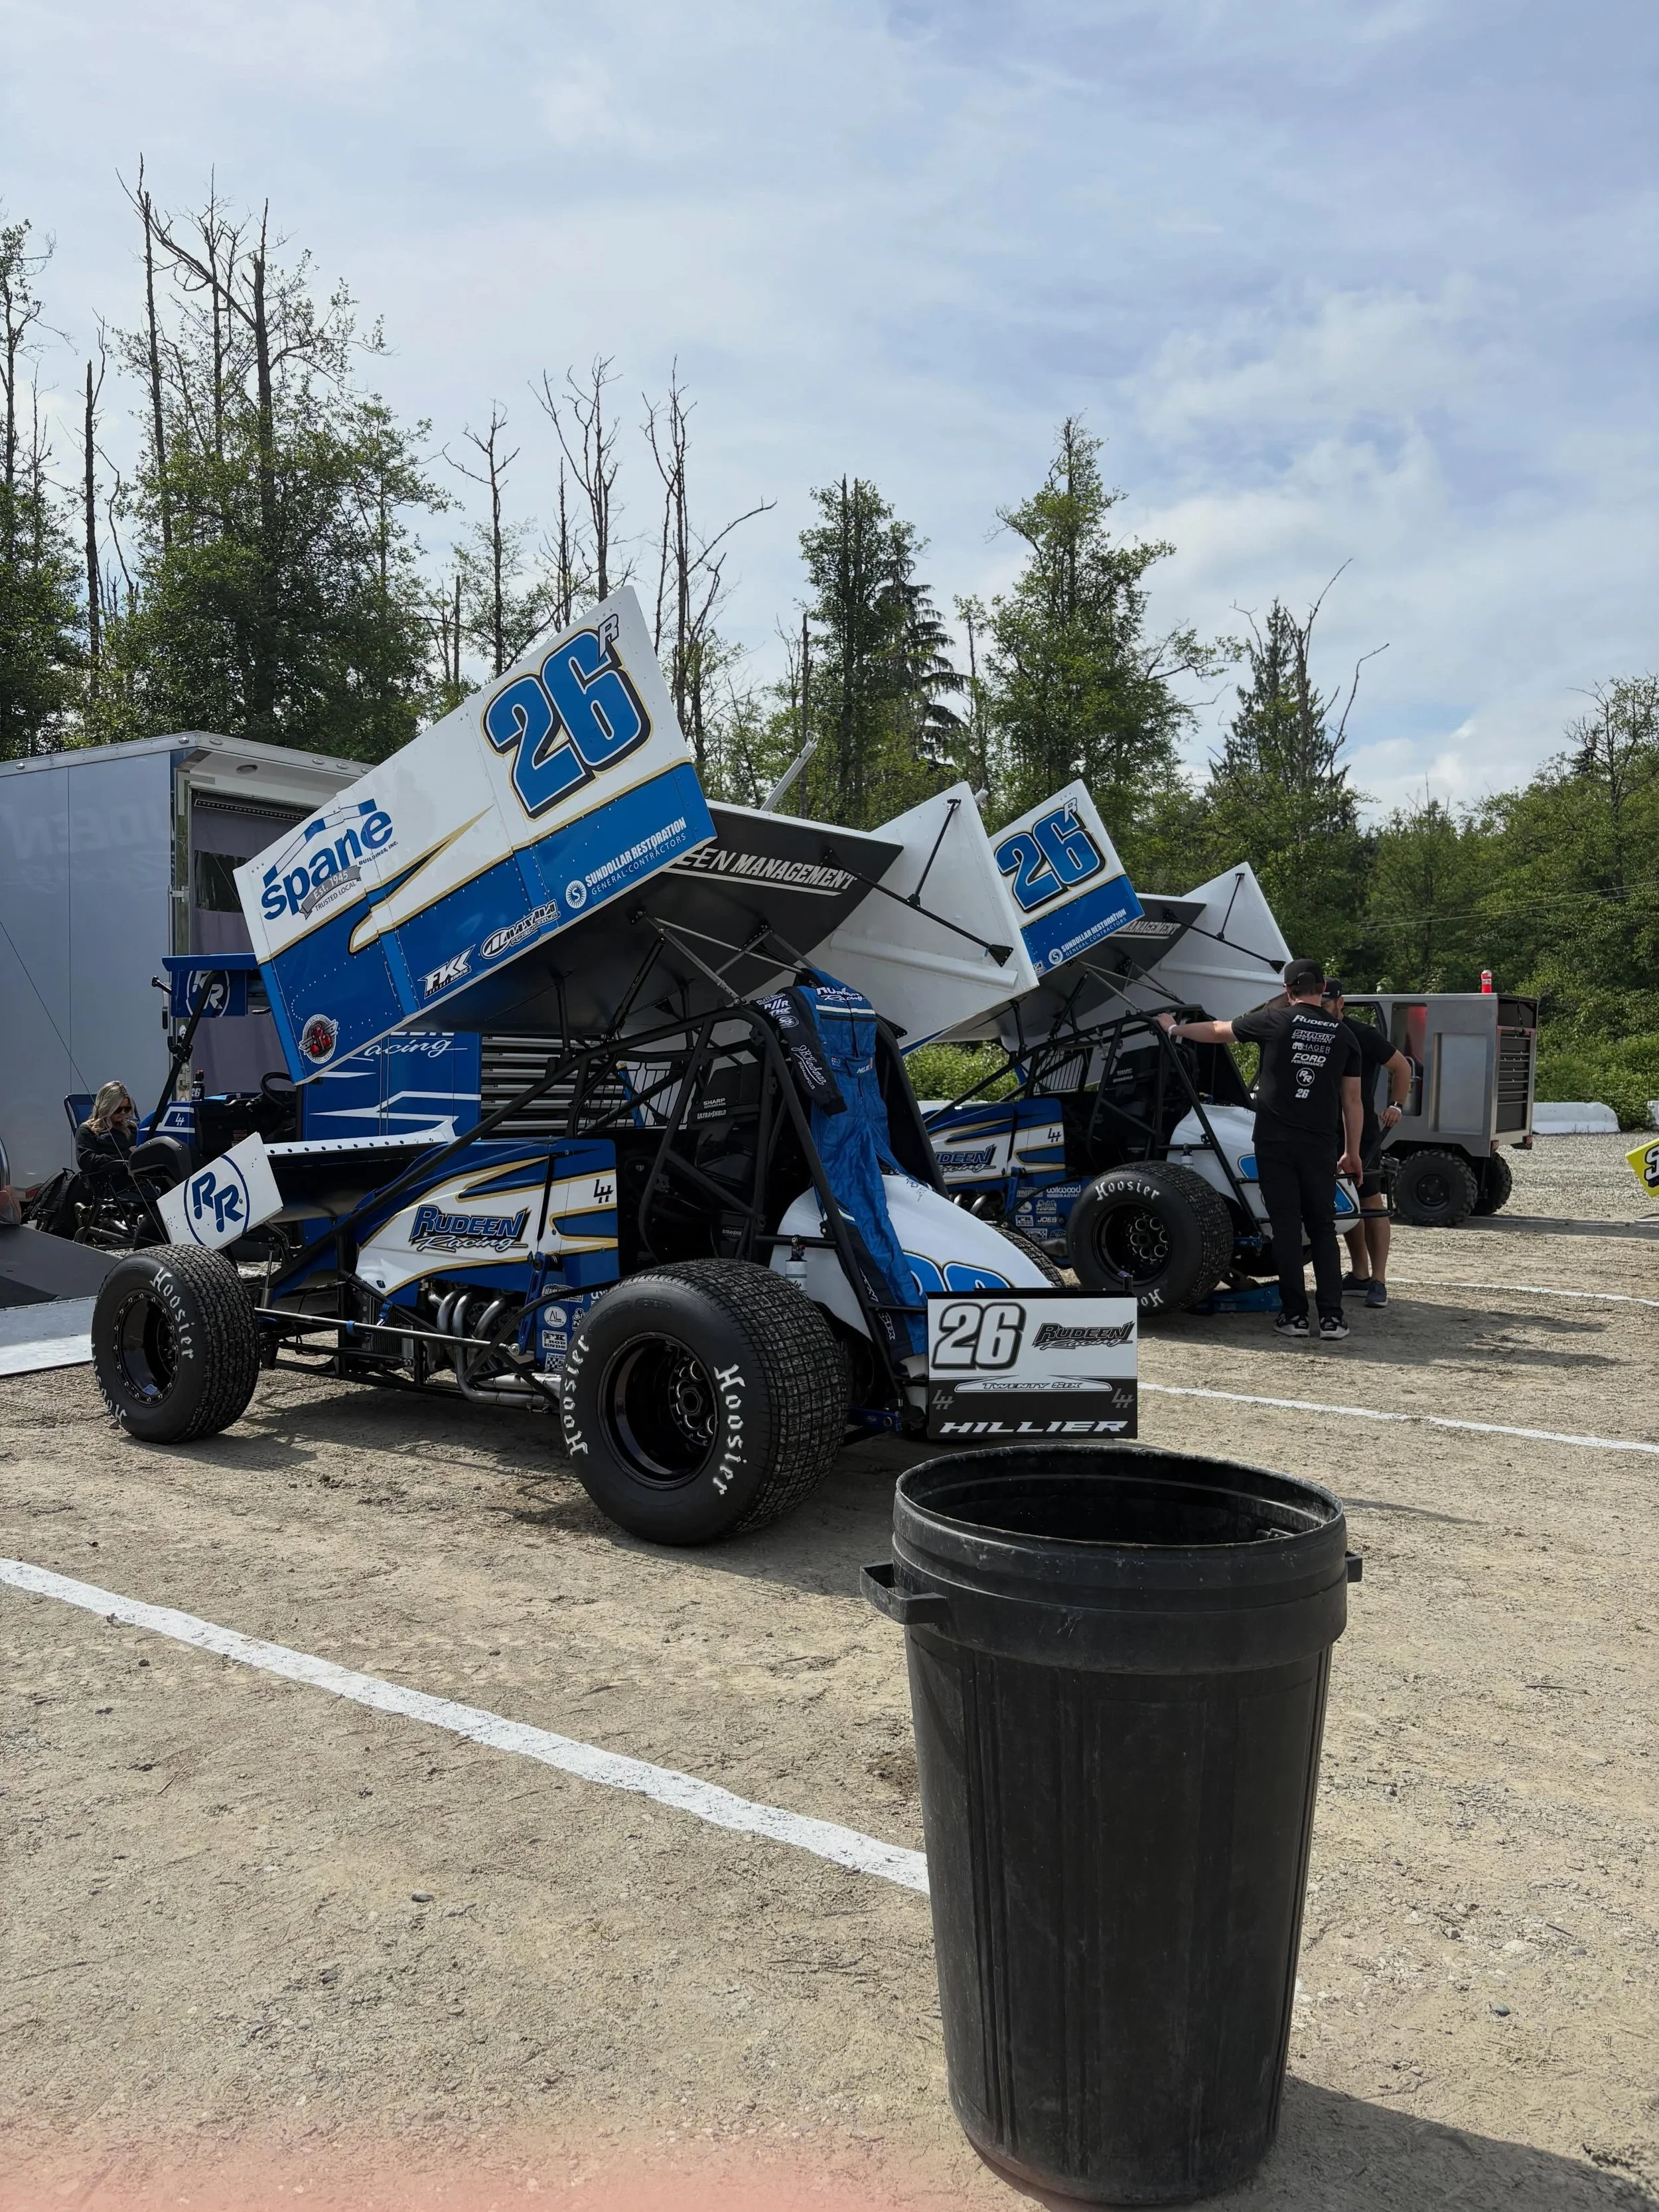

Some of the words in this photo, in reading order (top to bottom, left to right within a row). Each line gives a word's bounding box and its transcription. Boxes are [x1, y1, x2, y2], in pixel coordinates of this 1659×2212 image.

[482, 627, 652, 819] 26
[261, 812, 393, 920] spane
[585, 849, 632, 887] SUNDOLLAR
[630, 817, 687, 859] RESTORATION
[591, 872, 626, 895] GENERAL
[628, 833, 687, 873] CONTRACTORS
[996, 808, 1106, 913] 26
[313, 885, 328, 900] Est.
[330, 870, 348, 886] 1945
[729, 853, 858, 890] MANAGEMENT
[315, 893, 338, 912] TRUSTED
[338, 882, 356, 896] LOCAL
[1061, 930, 1092, 952] SUNDOLLAR
[1090, 908, 1127, 934] RESTORATION
[1066, 941, 1088, 956] GENERAL
[1090, 917, 1127, 942] CONTRACTORS
[1292, 1015, 1339, 1028] RUDEEN
[1293, 1029, 1336, 1041] SKAGIT
[362, 1039, 459, 1059] acing
[1293, 1053, 1327, 1063] FORD
[1303, 1043, 1331, 1054] HAGER
[1295, 1088, 1310, 1098] 26
[1046, 1184, 1081, 1194] wilwood
[1096, 1179, 1161, 1201] Hoosier
[410, 1205, 530, 1241] RUDEEN
[415, 1235, 528, 1252] Racing
[149, 1267, 195, 1359] Hoosier
[930, 1301, 1027, 1370] 26
[1033, 1321, 1135, 1345] RUDEEN
[1040, 1338, 1133, 1351] Racing
[563, 1335, 590, 1456] Hoosier
[983, 1381, 1050, 1390] TWENTY
[713, 1363, 748, 1495] Hoosier
[939, 1420, 1129, 1433] HILLIER
